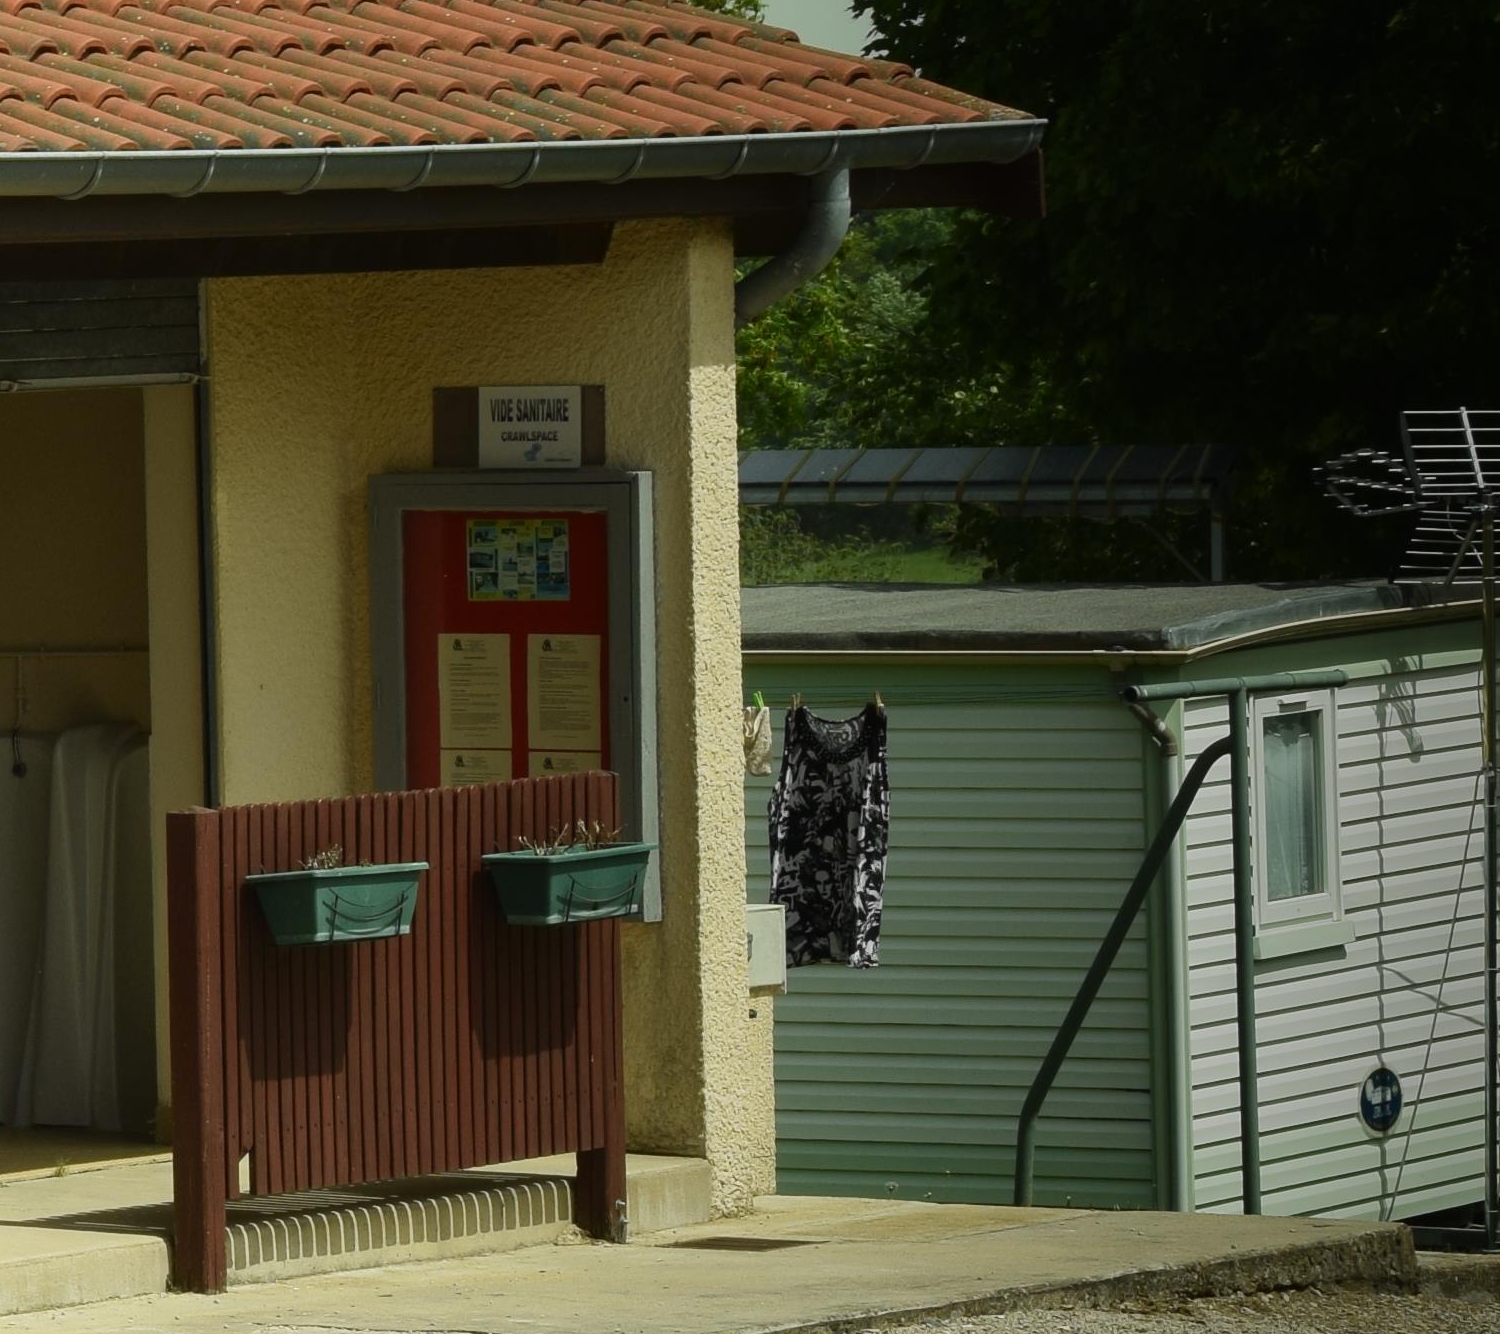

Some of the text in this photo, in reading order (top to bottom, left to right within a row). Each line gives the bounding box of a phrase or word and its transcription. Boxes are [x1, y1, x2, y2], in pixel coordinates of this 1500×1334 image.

[490, 398, 569, 422] VIDE SANITAIRE
[501, 430, 559, 442] CRAWLSPACE
